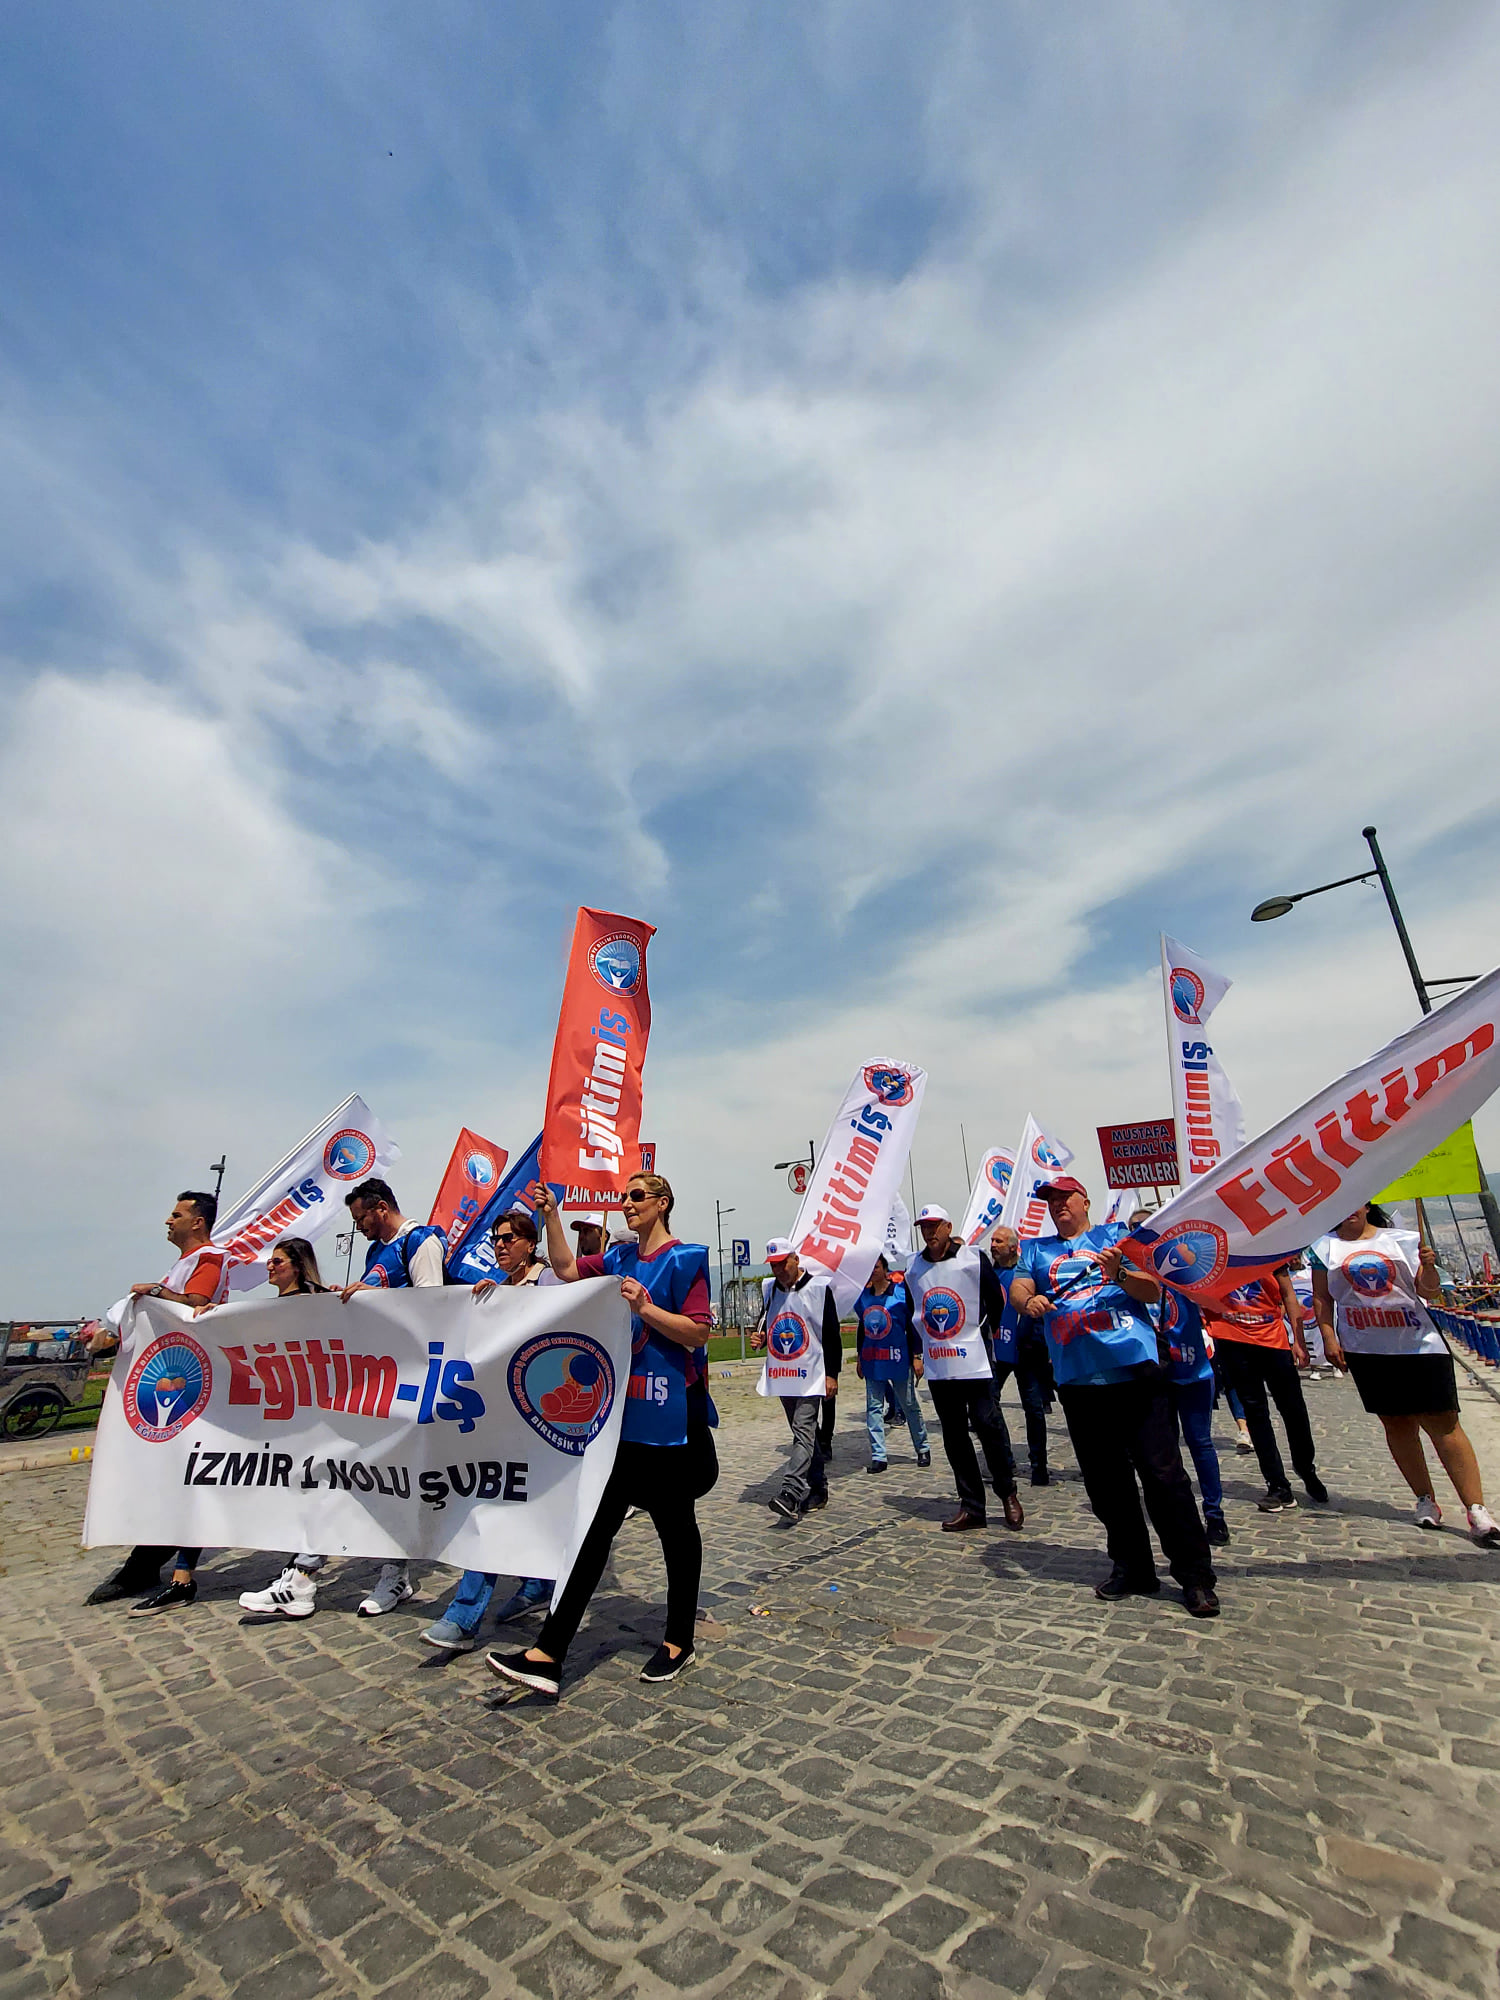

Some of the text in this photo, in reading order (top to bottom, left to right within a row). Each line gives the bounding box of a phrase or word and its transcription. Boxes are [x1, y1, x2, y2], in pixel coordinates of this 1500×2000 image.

[578, 1007, 632, 1175] Eğitimiş
[1111, 1125, 1169, 1142] MUSTAFA
[1112, 1138, 1177, 1158] KEMAL'İN
[1109, 1155, 1178, 1185] ASKERLERİ
[800, 1104, 893, 1273] Eğitimiş
[227, 1177, 325, 1269] ğitimiş
[734, 1241, 745, 1264] P
[1345, 1306, 1422, 1330] Eğitimiş
[768, 1367, 808, 1380] Eğitimiş
[184, 1442, 529, 1511] İZMİR 1 NOLU ŞUBE
